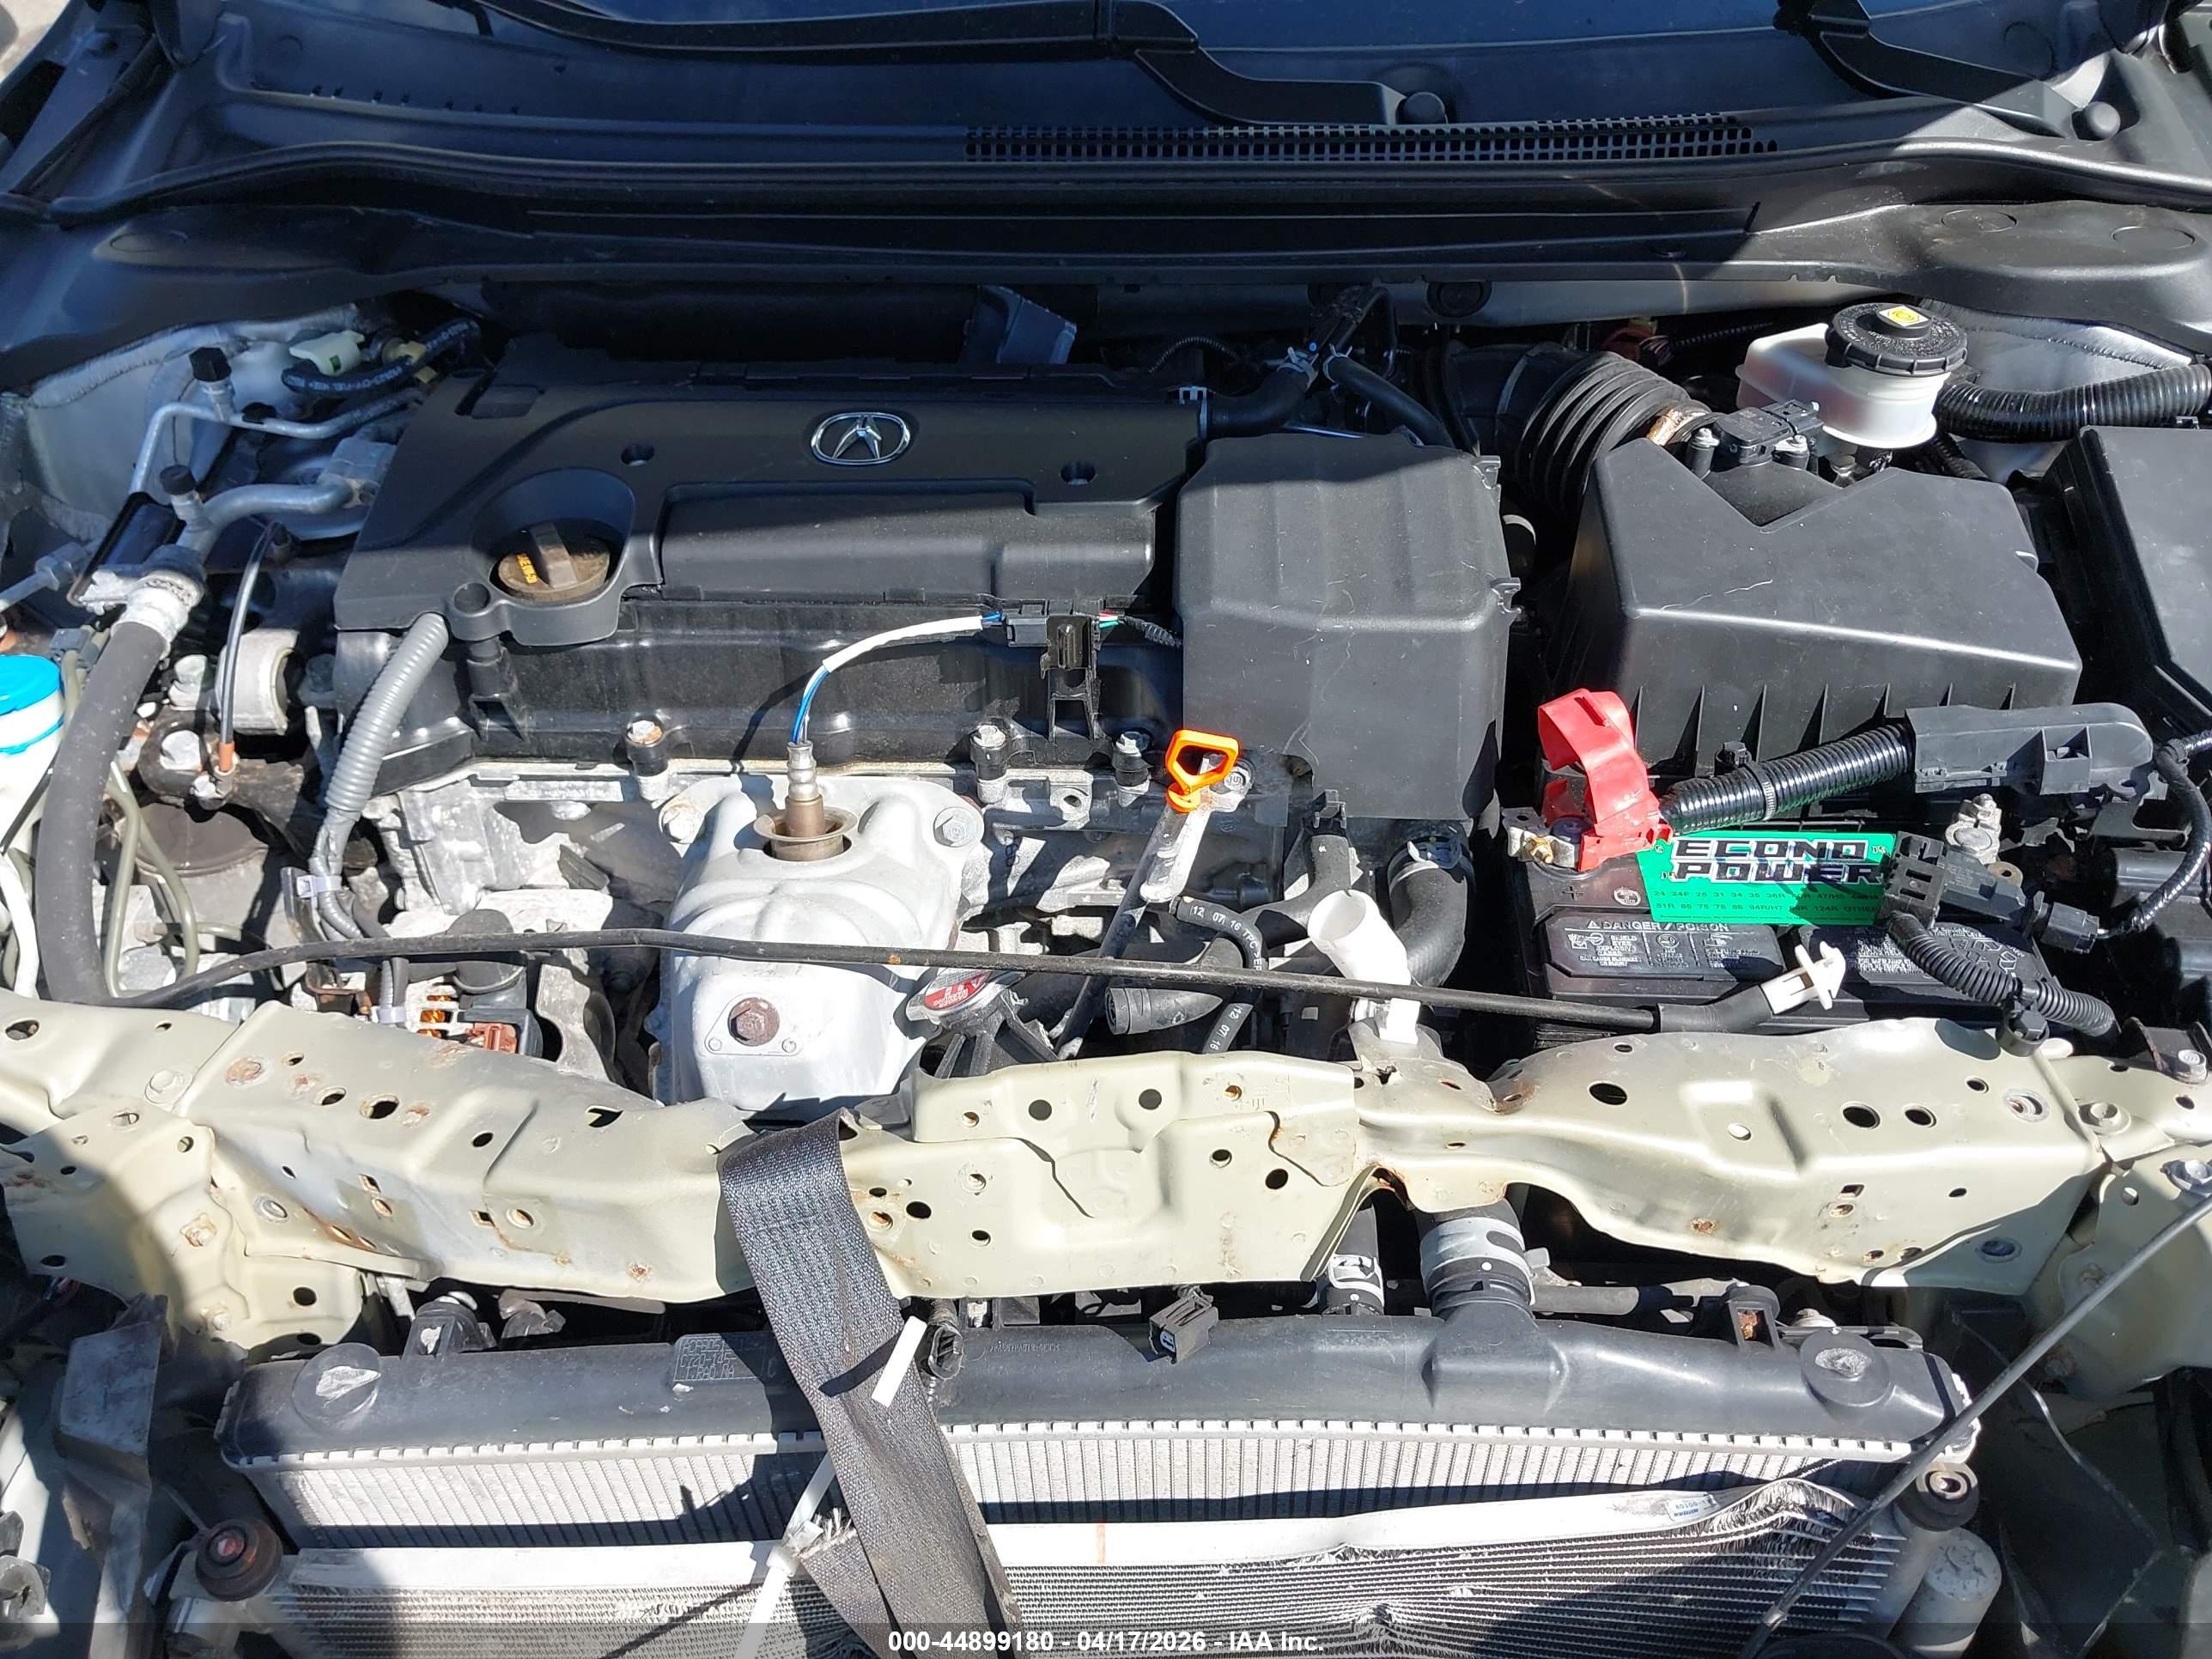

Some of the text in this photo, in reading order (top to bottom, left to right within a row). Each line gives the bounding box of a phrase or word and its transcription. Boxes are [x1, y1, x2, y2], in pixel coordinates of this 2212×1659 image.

[1672, 837, 1869, 860] ECONO
[1671, 860, 1883, 884] POWER
[1230, 920, 1242, 931] 16
[1243, 928, 1258, 949] TPC
[1602, 921, 1661, 931] DANGER
[1676, 921, 1729, 932] POISON
[1209, 1039, 1221, 1050] 16
